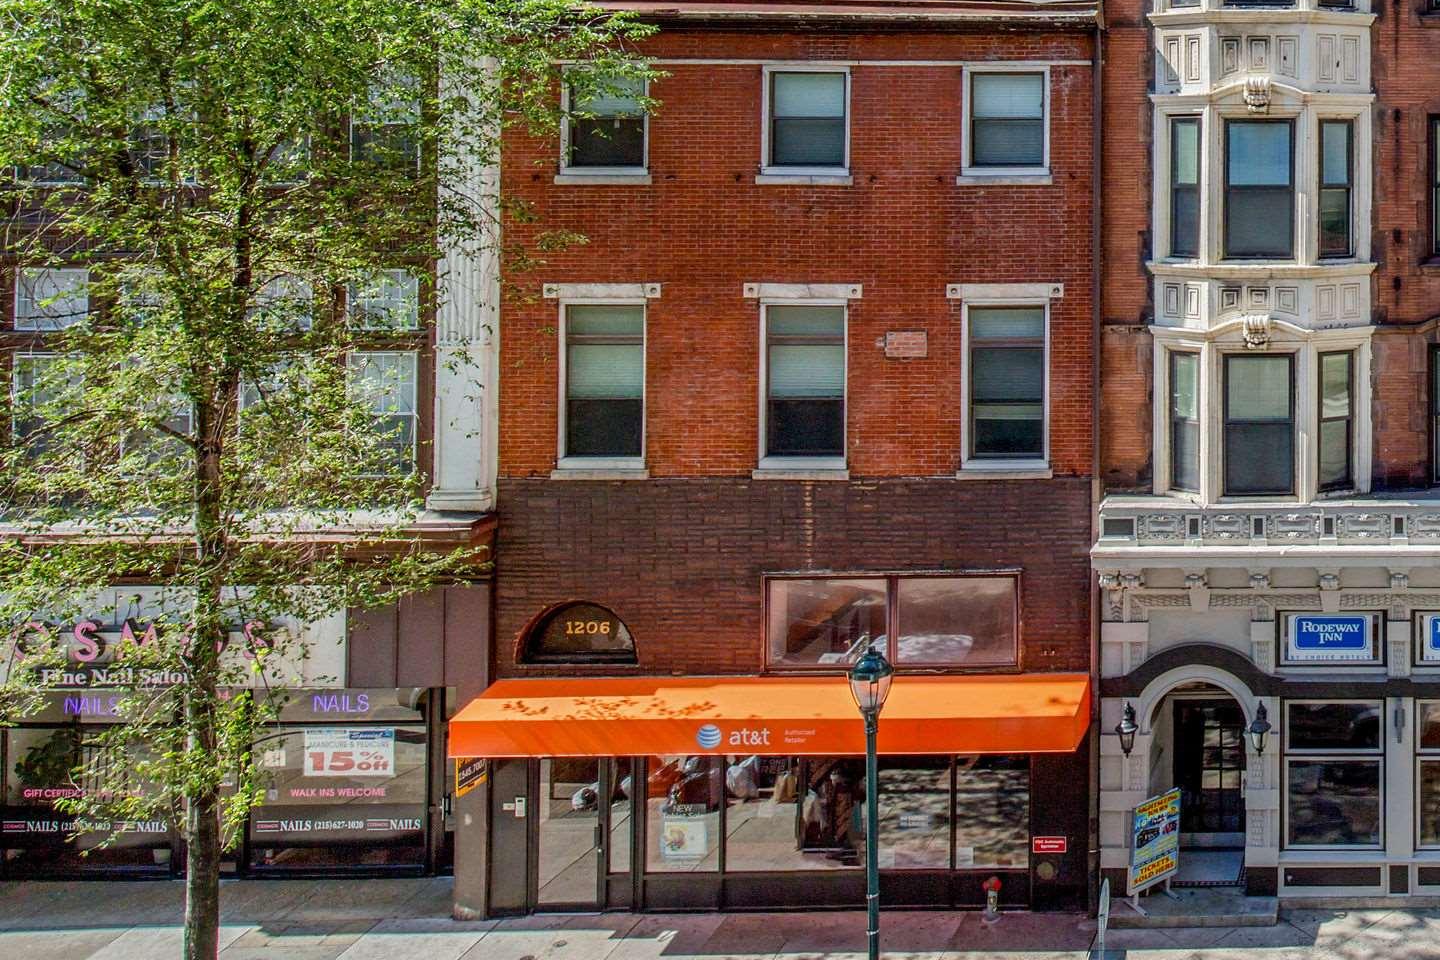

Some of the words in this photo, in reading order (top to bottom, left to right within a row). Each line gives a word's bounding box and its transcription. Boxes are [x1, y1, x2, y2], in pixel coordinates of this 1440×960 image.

[566, 621, 610, 634] 1206
[1302, 621, 1360, 633] RODEWAY
[1319, 633, 1343, 644] INN
[313, 694, 370, 713] NAILS
[24, 789, 42, 798] GIFT
[290, 789, 317, 797] WALK
[319, 789, 335, 797] INS
[337, 789, 387, 797] WELCOME
[27, 820, 59, 832] NAILS
[137, 821, 168, 832] NAILS
[280, 819, 312, 831] NAILS
[389, 818, 421, 830] NAILS
[1140, 856, 1170, 876] TICKETS
